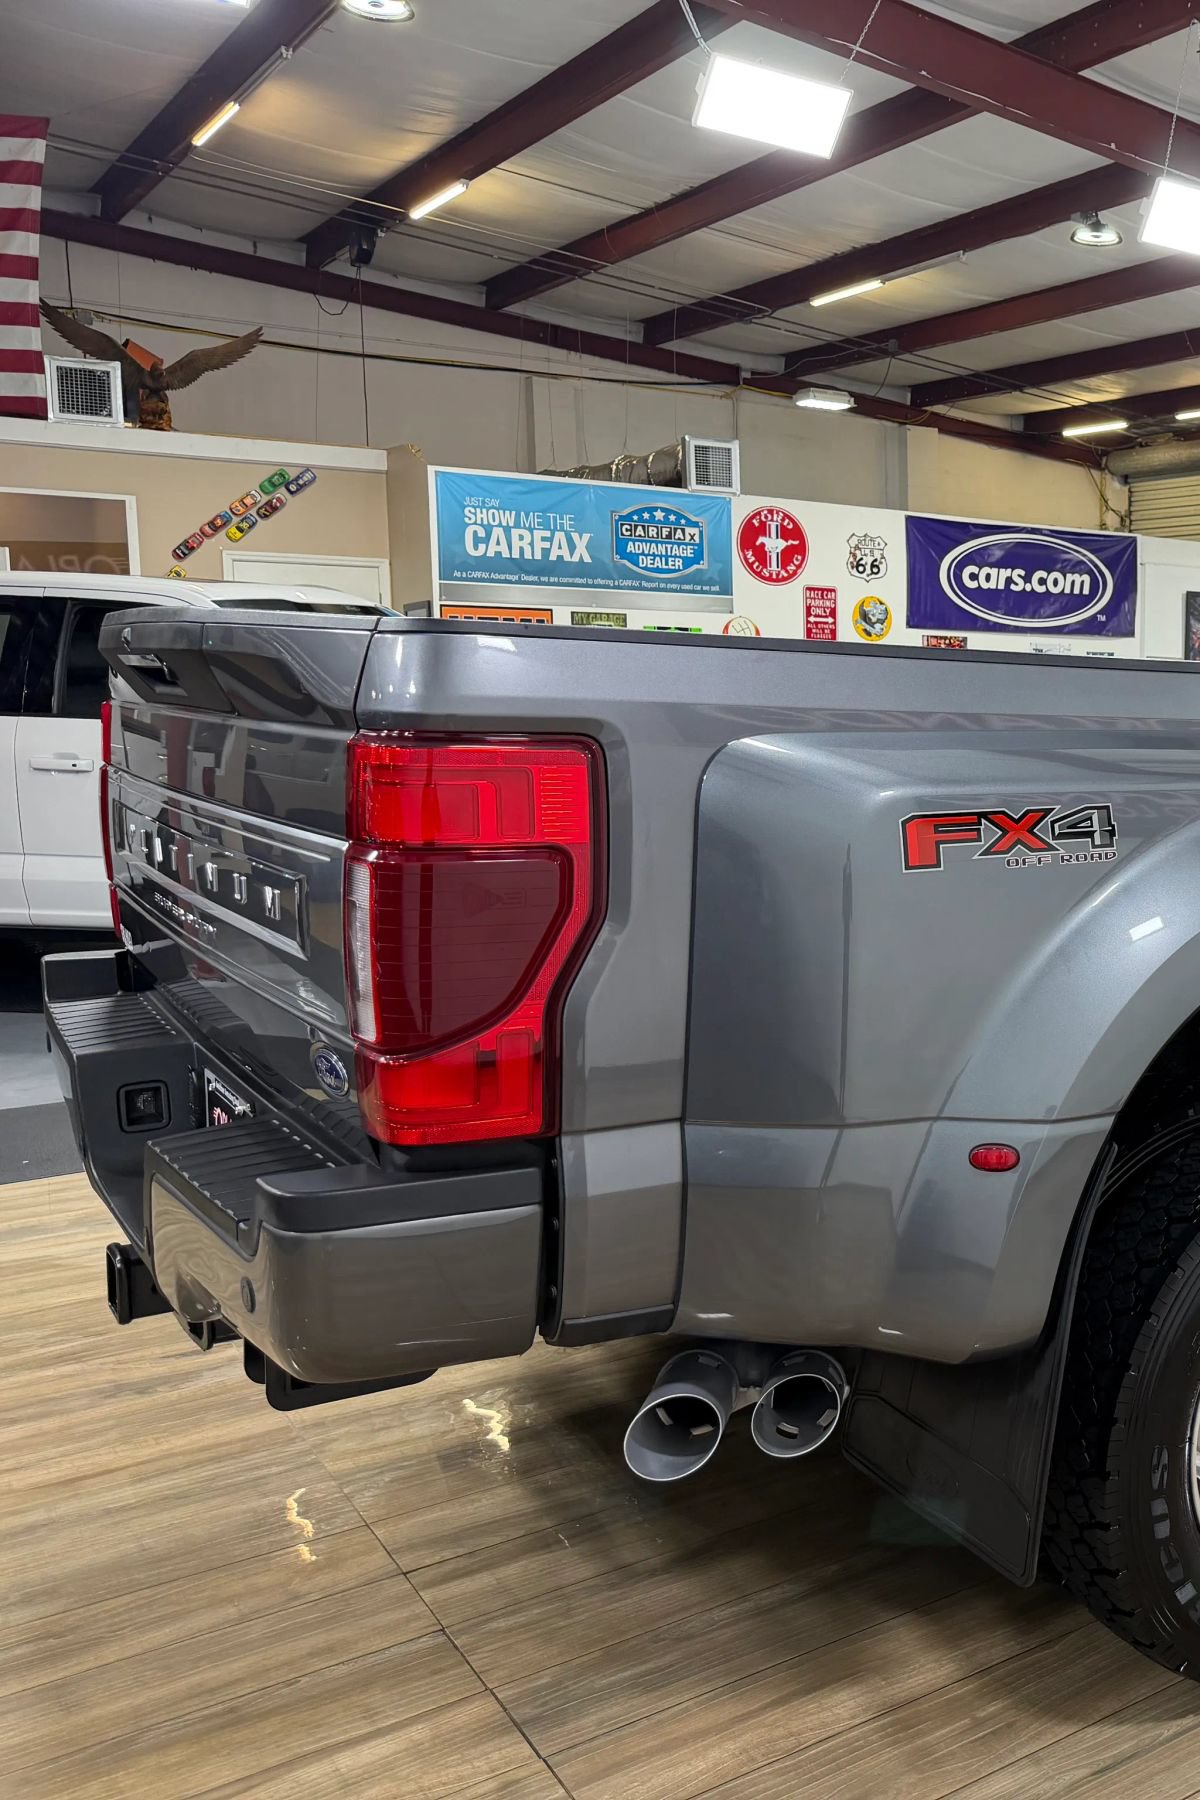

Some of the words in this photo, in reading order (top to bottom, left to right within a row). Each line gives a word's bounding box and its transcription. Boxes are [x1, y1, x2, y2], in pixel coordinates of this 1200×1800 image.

[464, 496, 483, 506] JUST
[484, 498, 500, 507] SAY
[464, 507, 516, 527] SHOW
[520, 511, 543, 529] ME
[547, 513, 575, 531] THE
[752, 510, 793, 529] FORD
[621, 524, 697, 542] CARFAX
[464, 524, 593, 563] CARFAX
[626, 541, 695, 557] ADVANTAGE
[857, 538, 877, 547] ROUTE
[638, 555, 683, 570] DEALER
[744, 549, 802, 579] MUSTANG
[856, 557, 880, 575] 66
[467, 570, 490, 579] CARFAX
[559, 576, 586, 584] committed
[594, 578, 614, 586] offering
[642, 580, 658, 589] Report
[667, 583, 680, 591] every
[961, 565, 1091, 595] cars.com
[806, 590, 822, 599] RACE
[823, 591, 835, 600] CAR
[806, 599, 835, 608] PARKING
[574, 613, 587, 625] MY
[810, 606, 831, 616] ONLY
[899, 803, 1118, 873] FX4
[1004, 854, 1052, 869] OFF
[1059, 851, 1118, 865] ROAD
